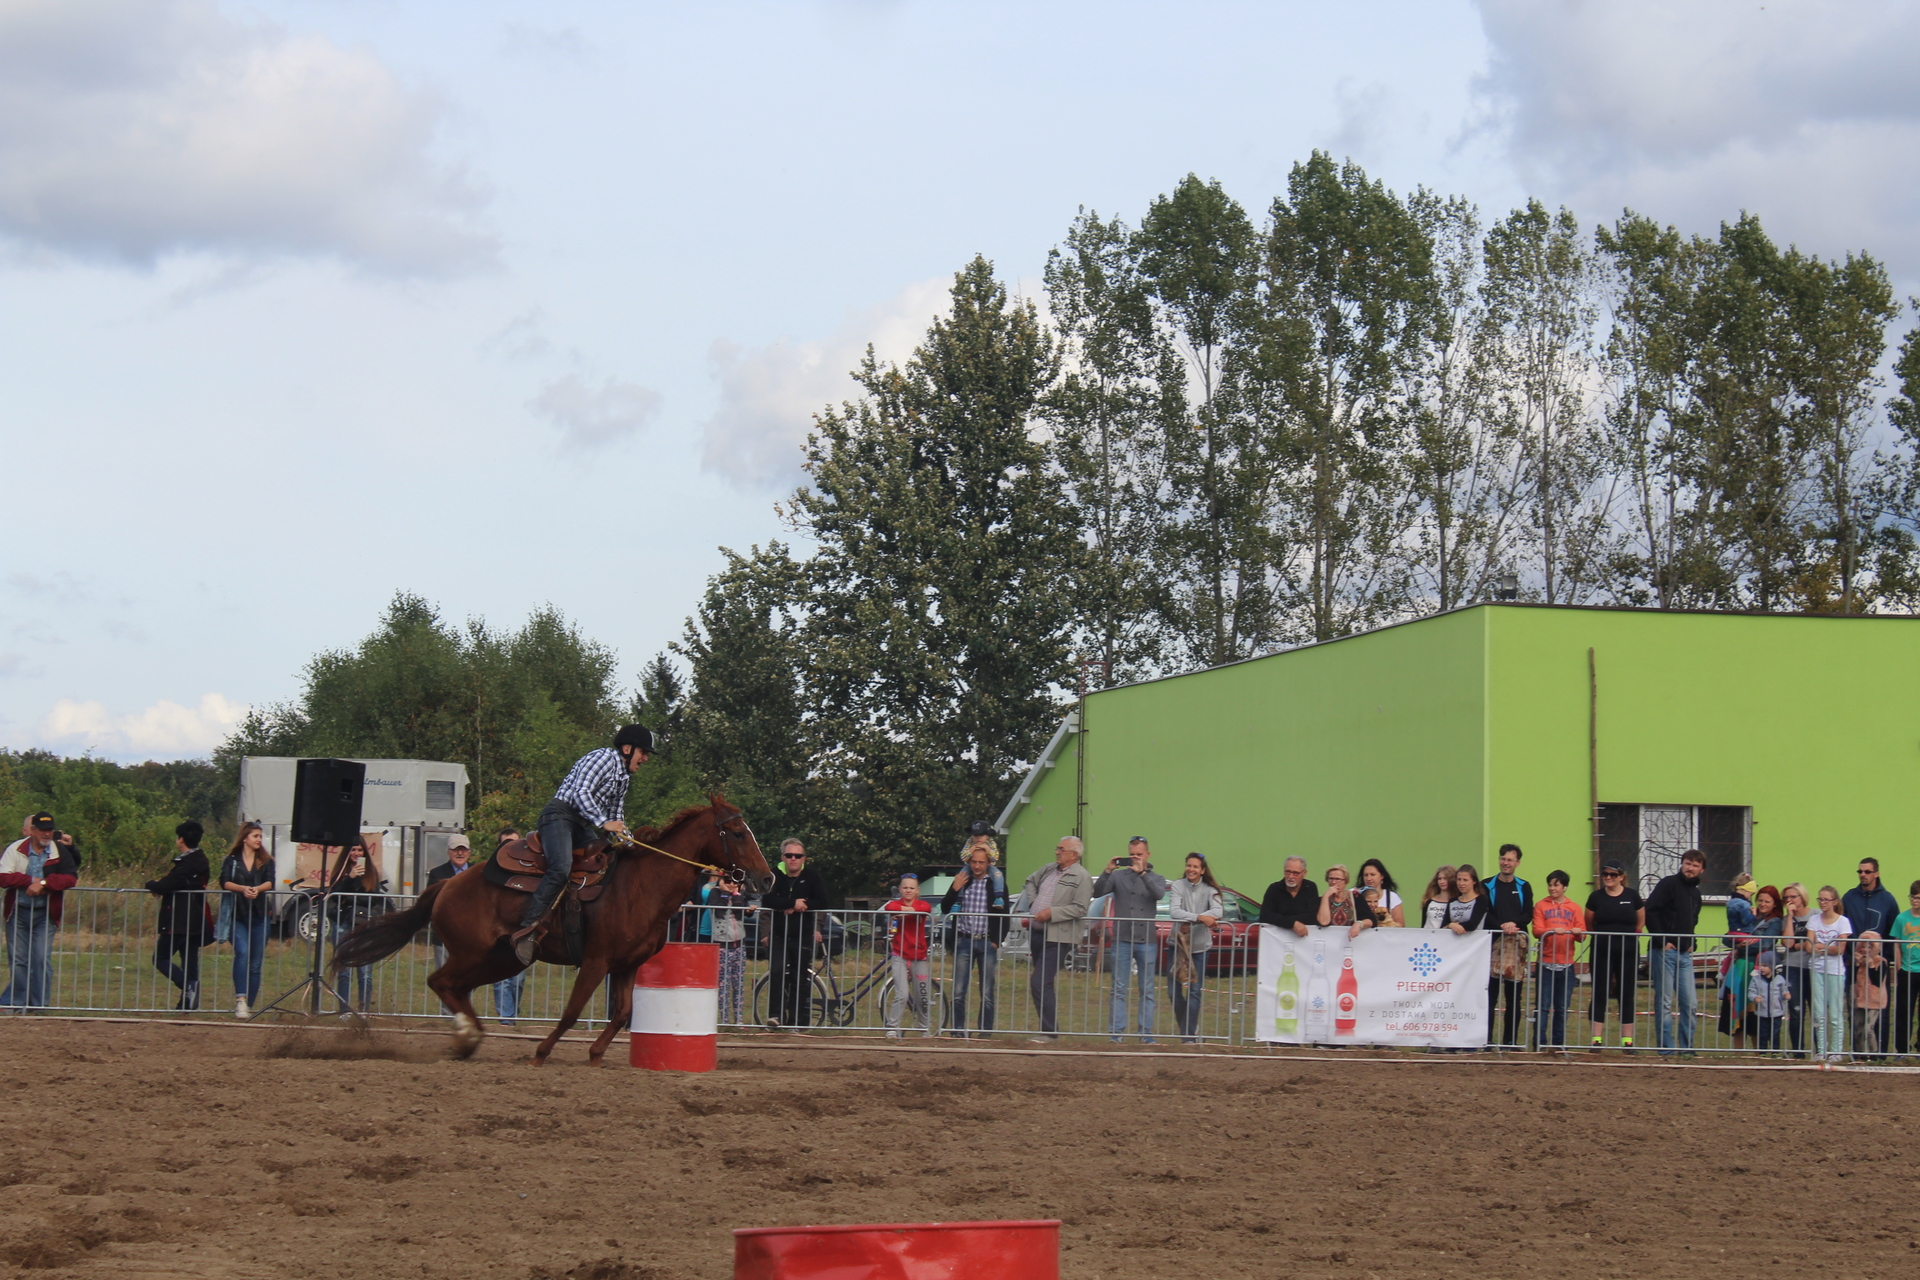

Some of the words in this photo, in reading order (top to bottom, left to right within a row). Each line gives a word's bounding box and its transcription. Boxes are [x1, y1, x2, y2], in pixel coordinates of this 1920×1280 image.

[1396, 981, 1452, 992] PIERROT
[1430, 1001, 1455, 1009] WODA
[1369, 1010, 1375, 1018] Z
[1382, 1011, 1426, 1020] DOSTAWĄ
[1452, 1012, 1476, 1020] DOMU
[1386, 1022, 1401, 1031] tel.
[1403, 1022, 1420, 1031] 606
[1422, 1023, 1439, 1031] 978
[1441, 1023, 1458, 1031] 594
